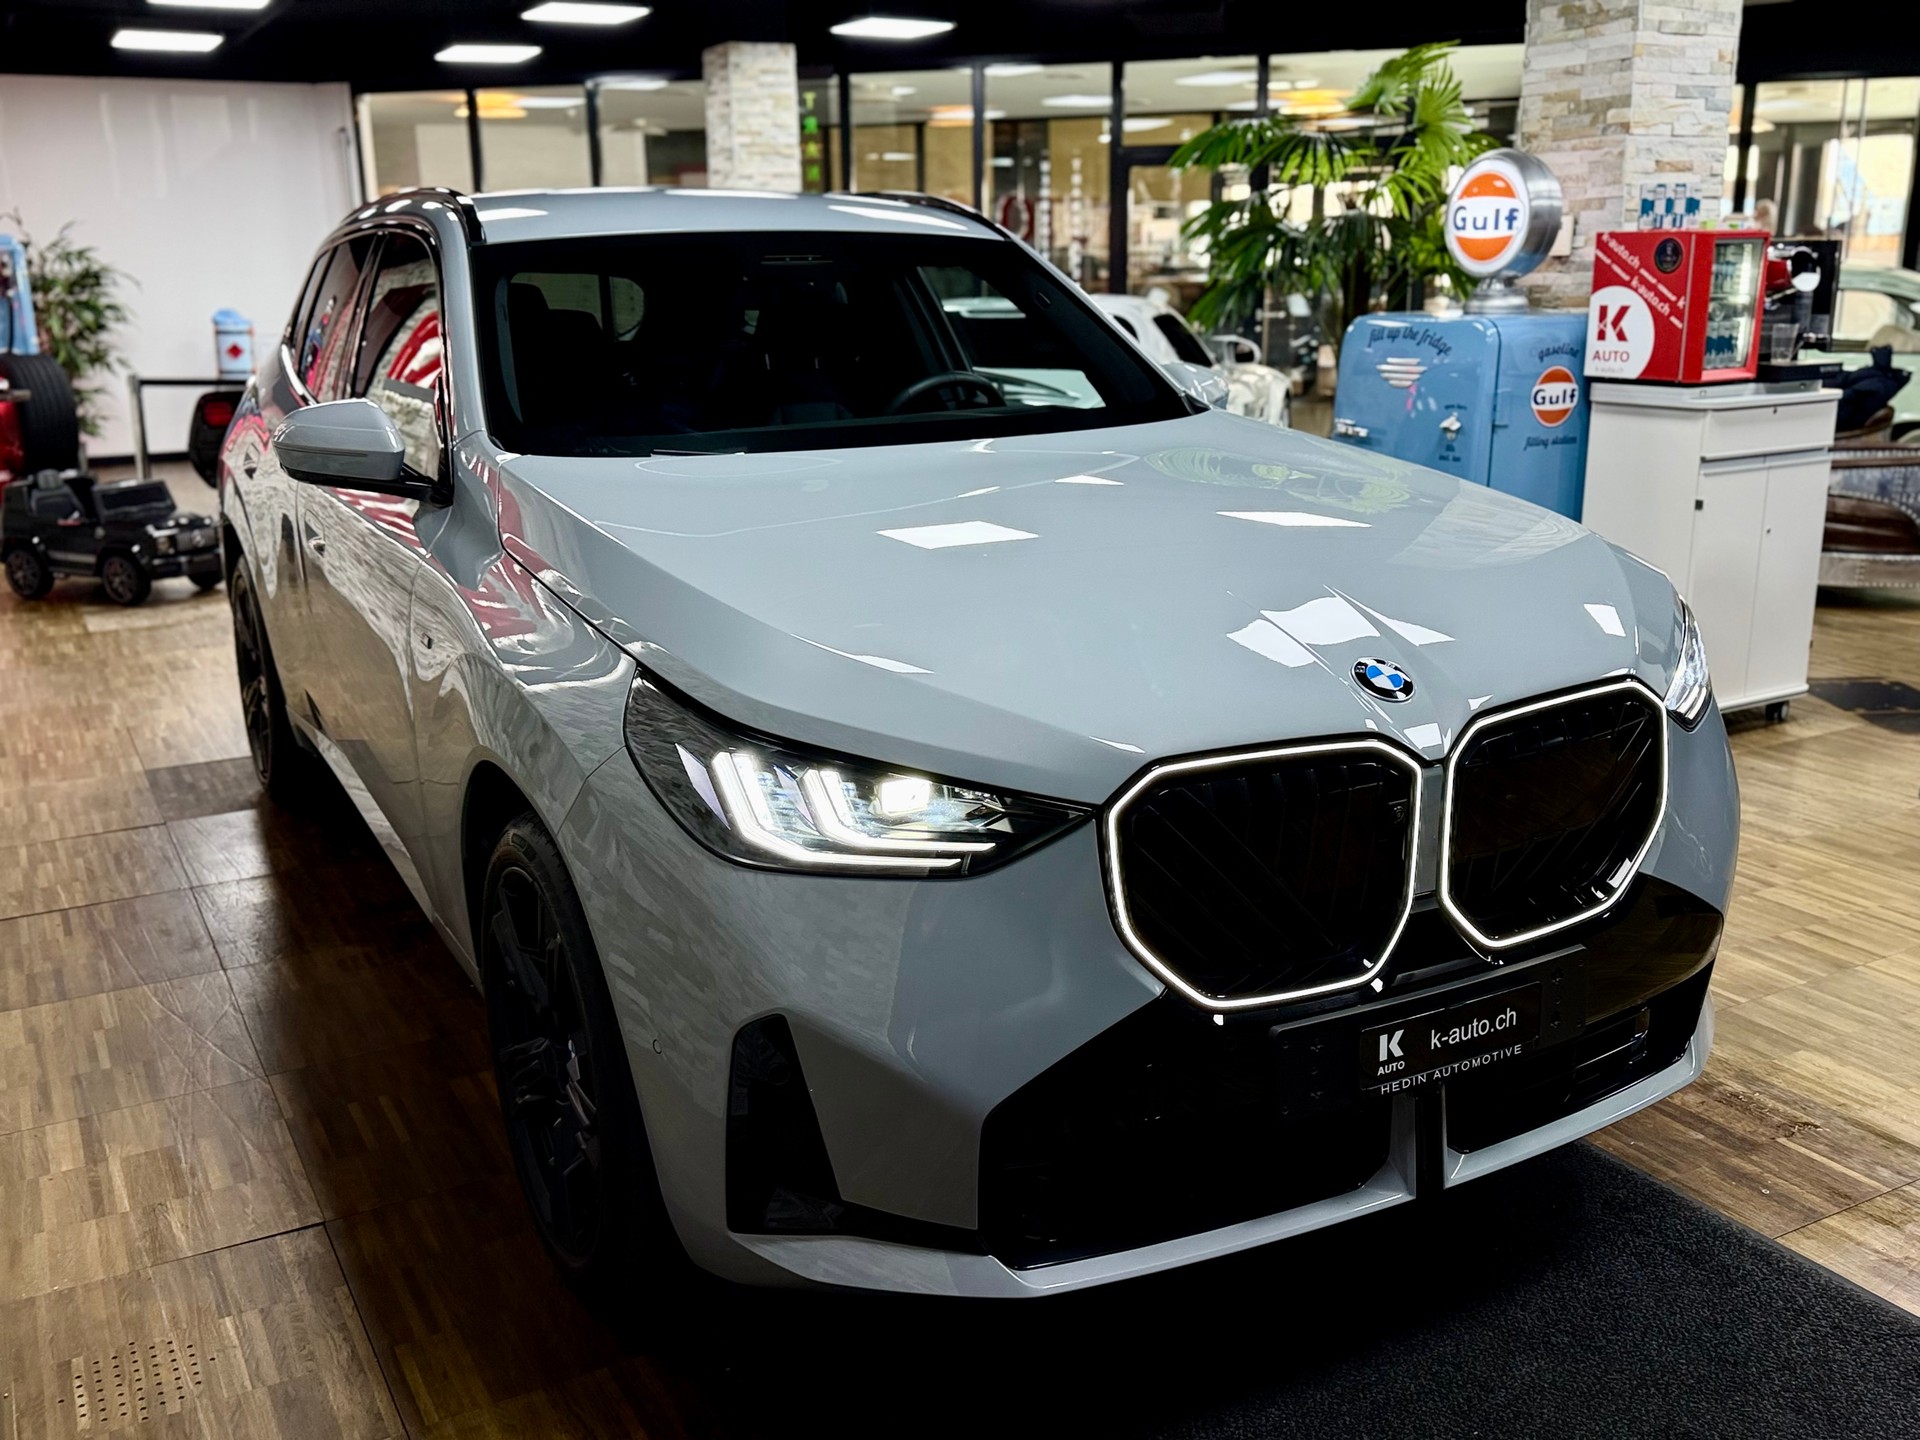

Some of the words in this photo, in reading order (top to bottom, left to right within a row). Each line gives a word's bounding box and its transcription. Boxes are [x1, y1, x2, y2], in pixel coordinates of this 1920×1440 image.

[1453, 205, 1520, 231] Gulf
[1602, 232, 1640, 269] k-auto.ch
[1630, 275, 1670, 316] k-auto.ch
[1597, 305, 1631, 342] K
[1402, 326, 1419, 341] the
[1416, 328, 1452, 356] fridge
[1538, 342, 1580, 363] gasoline
[1592, 350, 1630, 363] AUTO
[1533, 388, 1577, 406] Gulf
[1430, 1007, 1517, 1050] k-auto.ch
[1379, 1029, 1405, 1062] K
[1377, 1060, 1406, 1076] AUTO
[1381, 1073, 1428, 1095] HEDIN
[1433, 1043, 1523, 1080] AUTOMOTIVE
